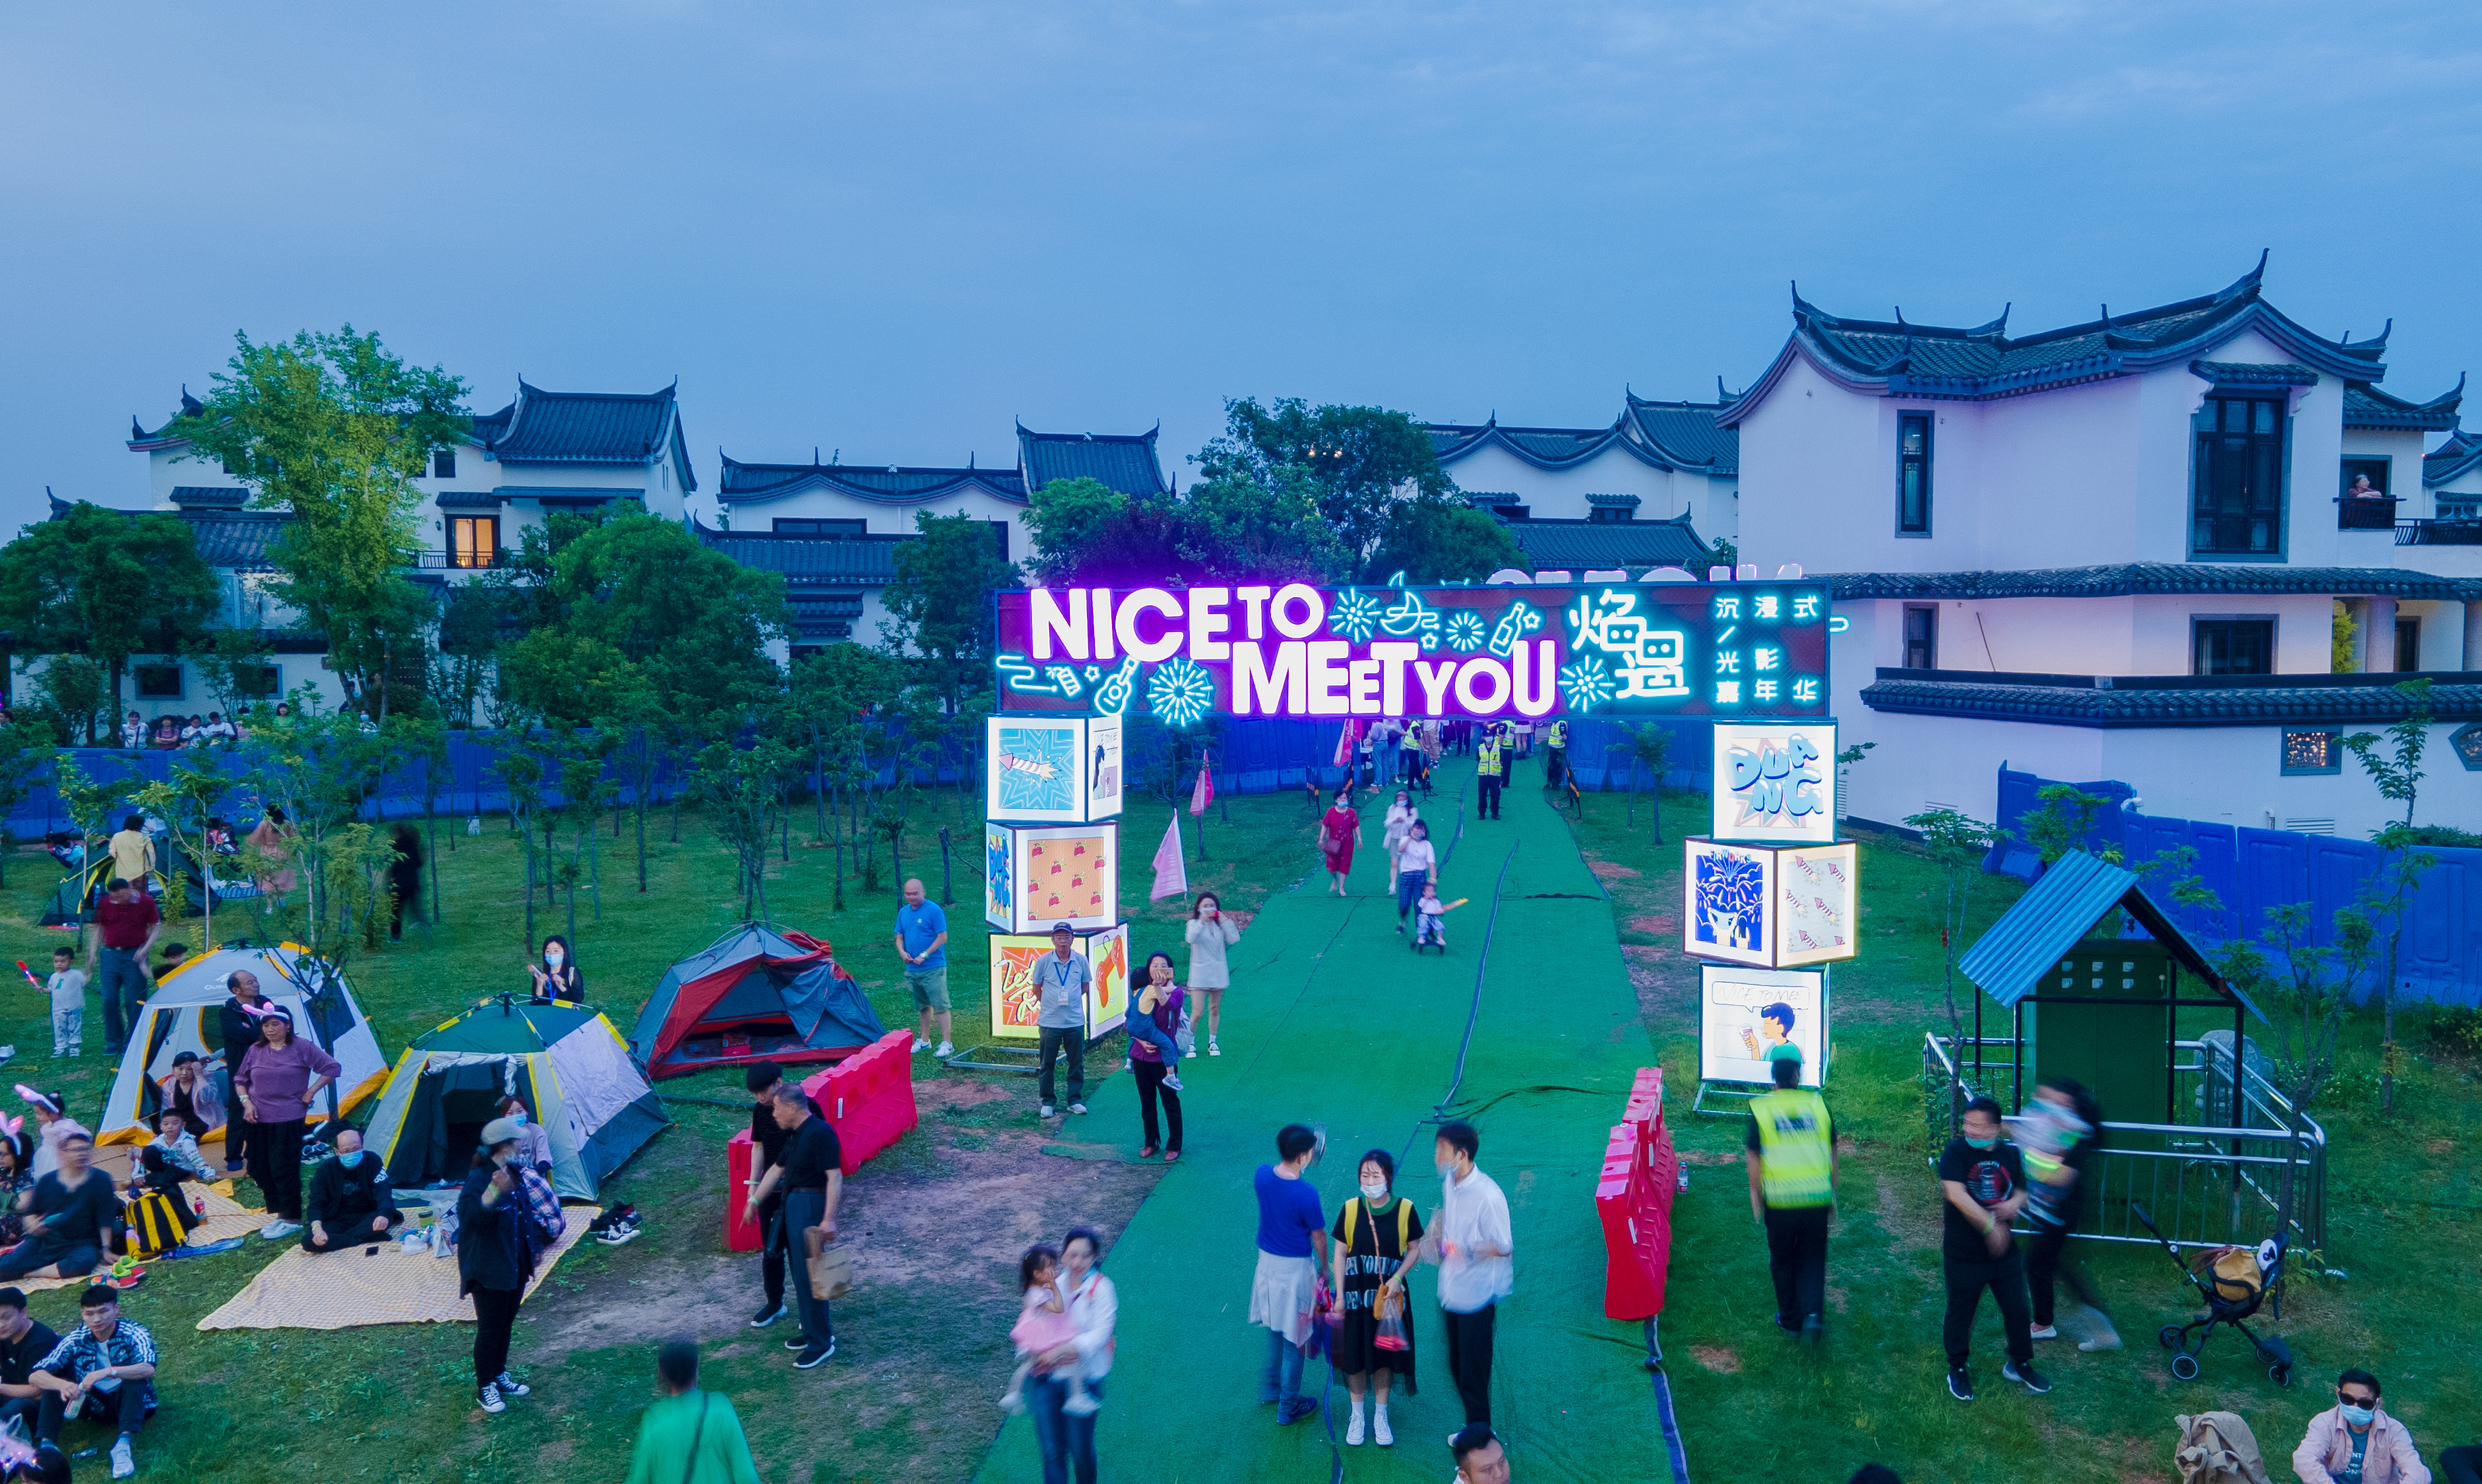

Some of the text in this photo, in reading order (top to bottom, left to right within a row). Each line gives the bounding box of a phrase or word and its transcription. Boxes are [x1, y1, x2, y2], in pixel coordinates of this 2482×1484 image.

[1716, 594, 1818, 619] 沉浸式
[1031, 583, 1324, 662] NICE TO
[1716, 648, 1778, 673] 光影
[1232, 640, 1555, 716] MEET YOU
[1716, 679, 1817, 703] 嘉年华
[1716, 983, 1754, 1001] NICE
